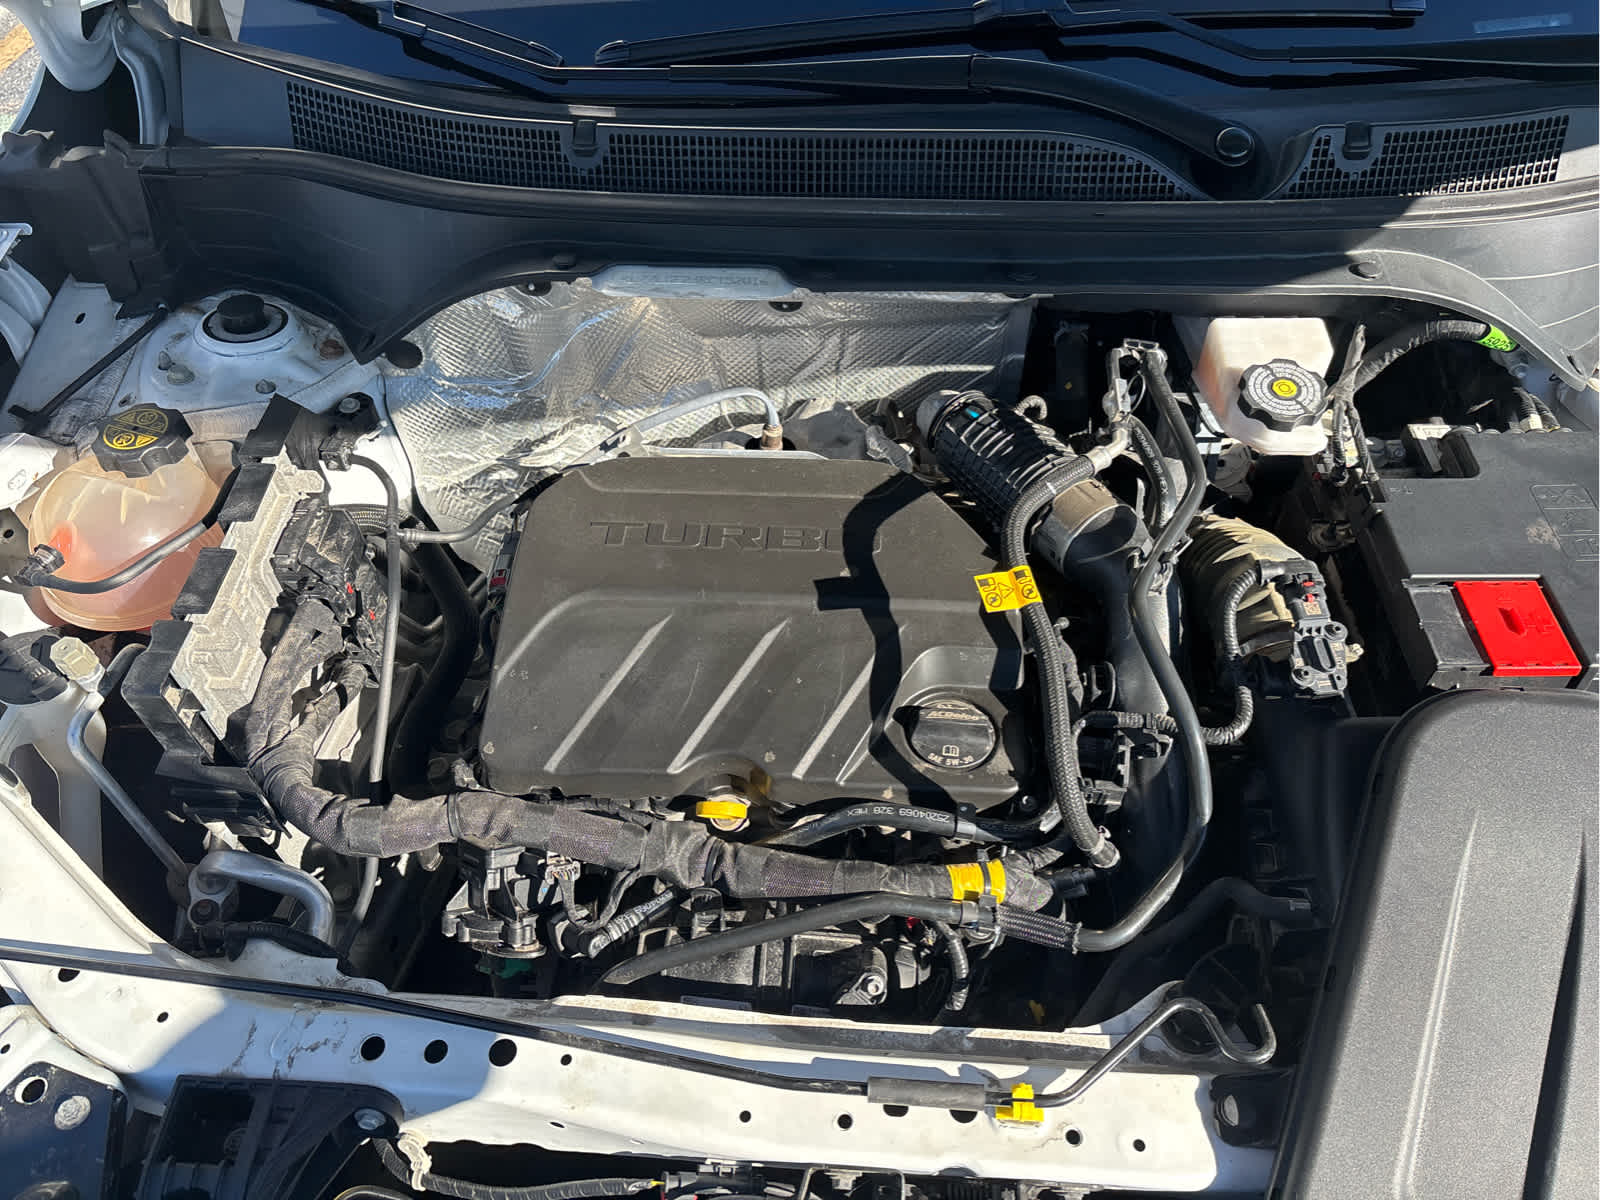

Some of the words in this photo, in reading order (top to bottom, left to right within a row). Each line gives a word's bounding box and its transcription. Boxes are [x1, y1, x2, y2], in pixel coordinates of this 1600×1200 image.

[590, 520, 883, 553] TURBO
[926, 710, 982, 721] ACDelco
[927, 752, 944, 764] SAE
[945, 755, 975, 766] 5W-30
[898, 807, 950, 823] 25204069
